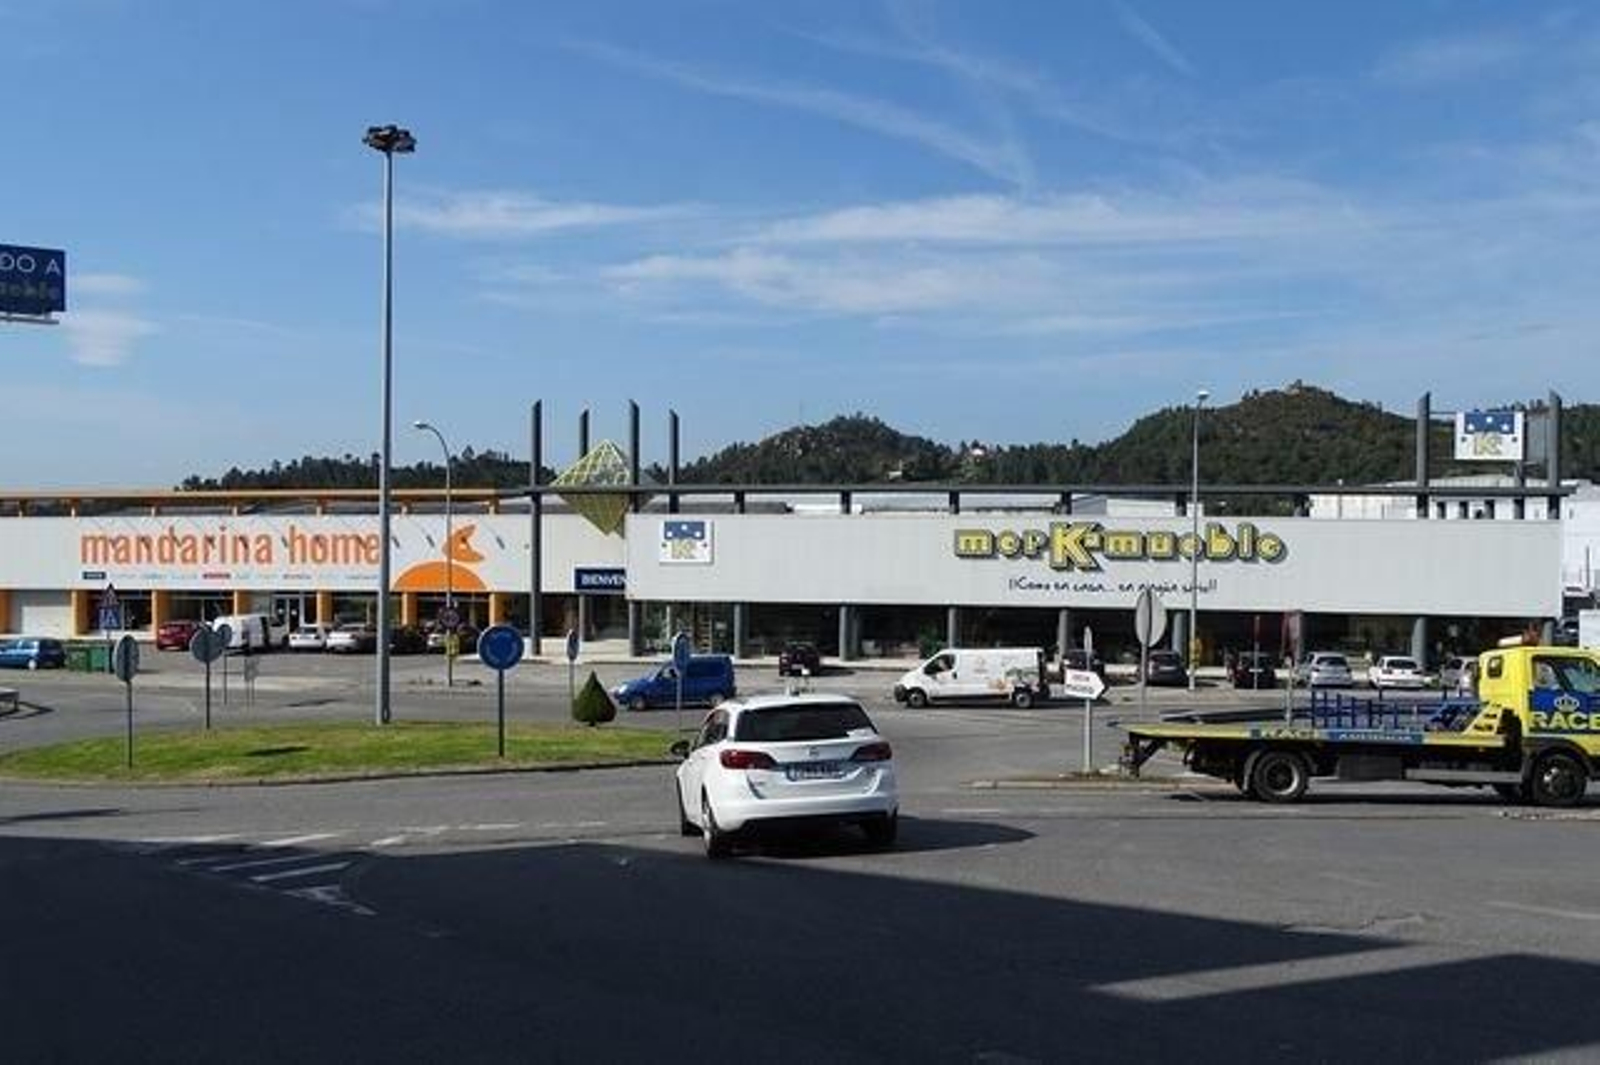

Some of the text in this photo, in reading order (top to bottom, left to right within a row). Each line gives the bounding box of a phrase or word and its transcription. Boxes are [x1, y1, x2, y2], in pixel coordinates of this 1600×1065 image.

[45, 258, 62, 276] A
[80, 524, 380, 565] mandarina home
[1528, 711, 1600, 730] RACE
